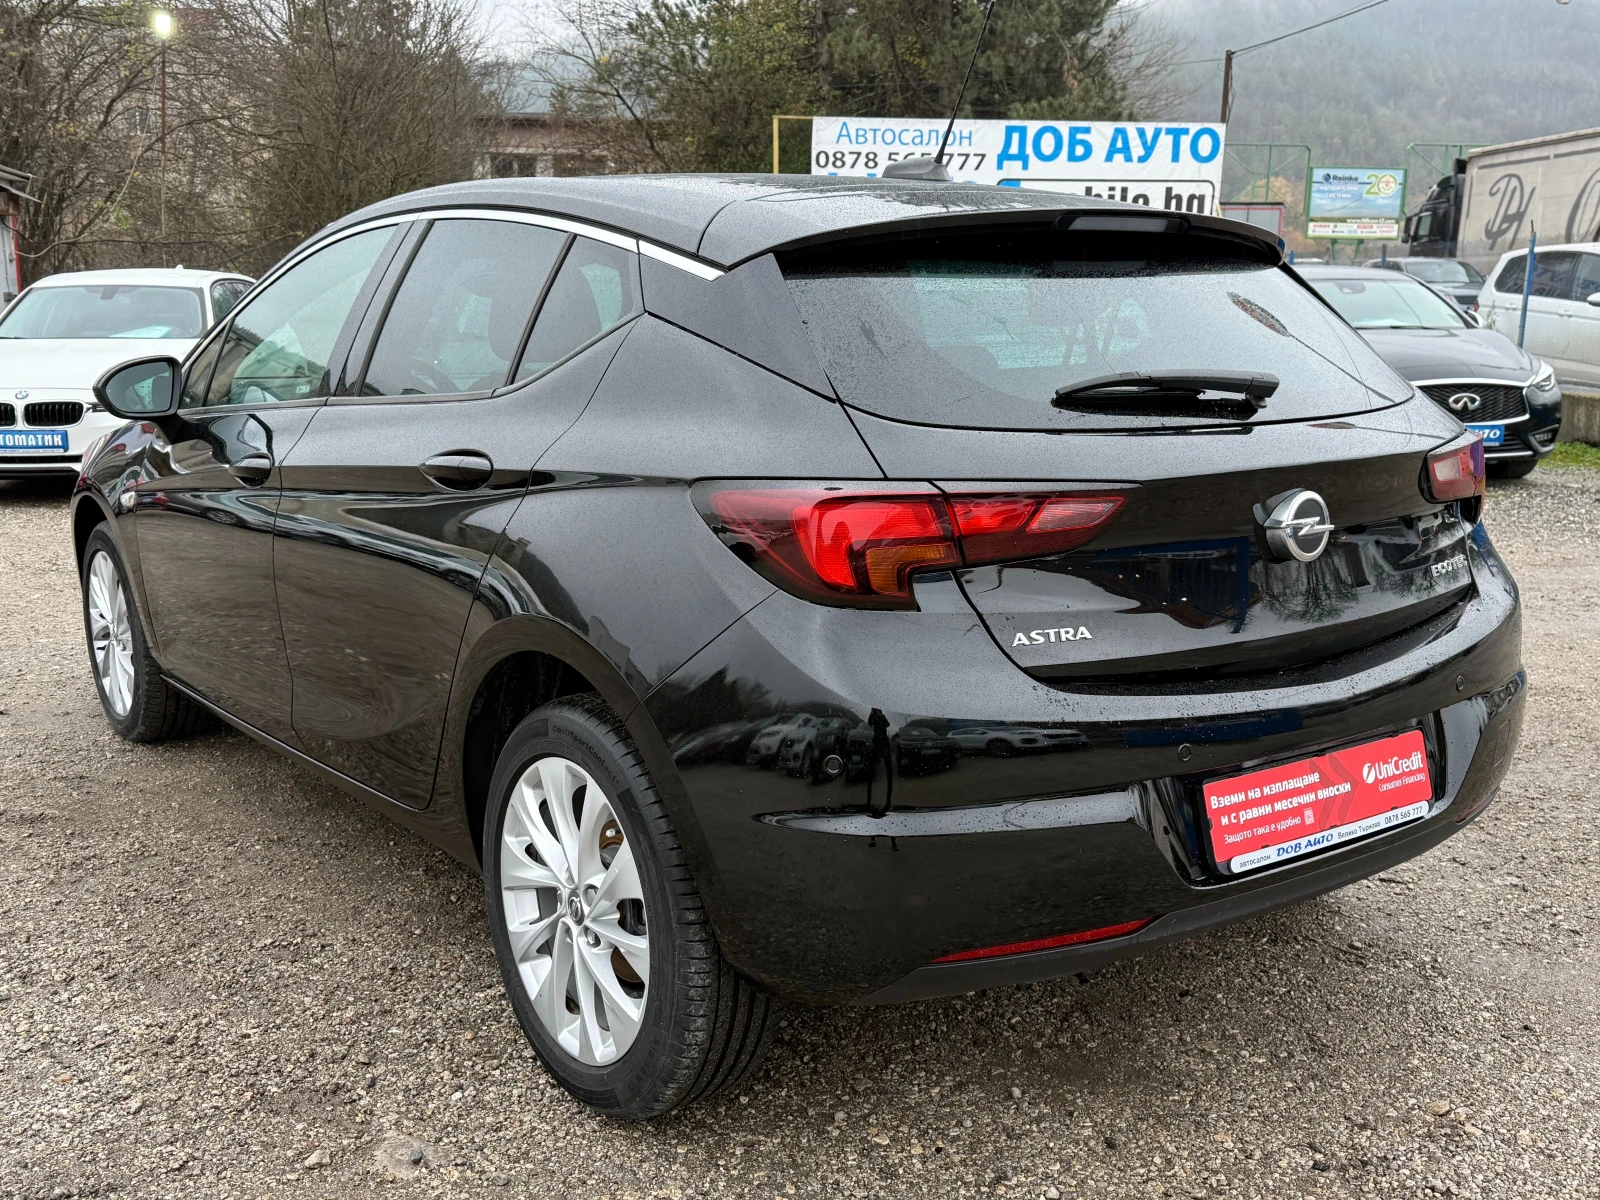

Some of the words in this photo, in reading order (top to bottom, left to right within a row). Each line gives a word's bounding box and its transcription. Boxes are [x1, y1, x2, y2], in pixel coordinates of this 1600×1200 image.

[836, 121, 973, 147] Автосалон
[997, 124, 1094, 171] ДОБ
[1104, 126, 1221, 165] АУТО
[815, 150, 878, 170] 0878
[1332, 174, 1359, 182] Reinke
[1011, 626, 1093, 648] ASTRA
[552, 724, 616, 782] ContiSportContact
[1375, 750, 1424, 780] UniCredit
[1210, 790, 1246, 809] Вземи
[1248, 787, 1261, 801] на
[1263, 771, 1320, 796] изплащане
[1378, 778, 1402, 792] Consumer
[1402, 772, 1426, 785] Financing
[1220, 815, 1229, 826] и
[1230, 813, 1238, 824] с
[1238, 804, 1272, 824] равни
[1274, 791, 1316, 813] месечни
[1317, 782, 1352, 800] вноски
[1223, 831, 1252, 845] Защото
[1253, 826, 1270, 836] така
[1271, 823, 1276, 832] е
[1277, 816, 1302, 832] удобно
[1239, 854, 1271, 868] автосалон
[1337, 829, 1358, 840] Велико
[1384, 813, 1400, 825] 0878
[1400, 809, 1411, 820] 565
[1411, 805, 1423, 816] 777
